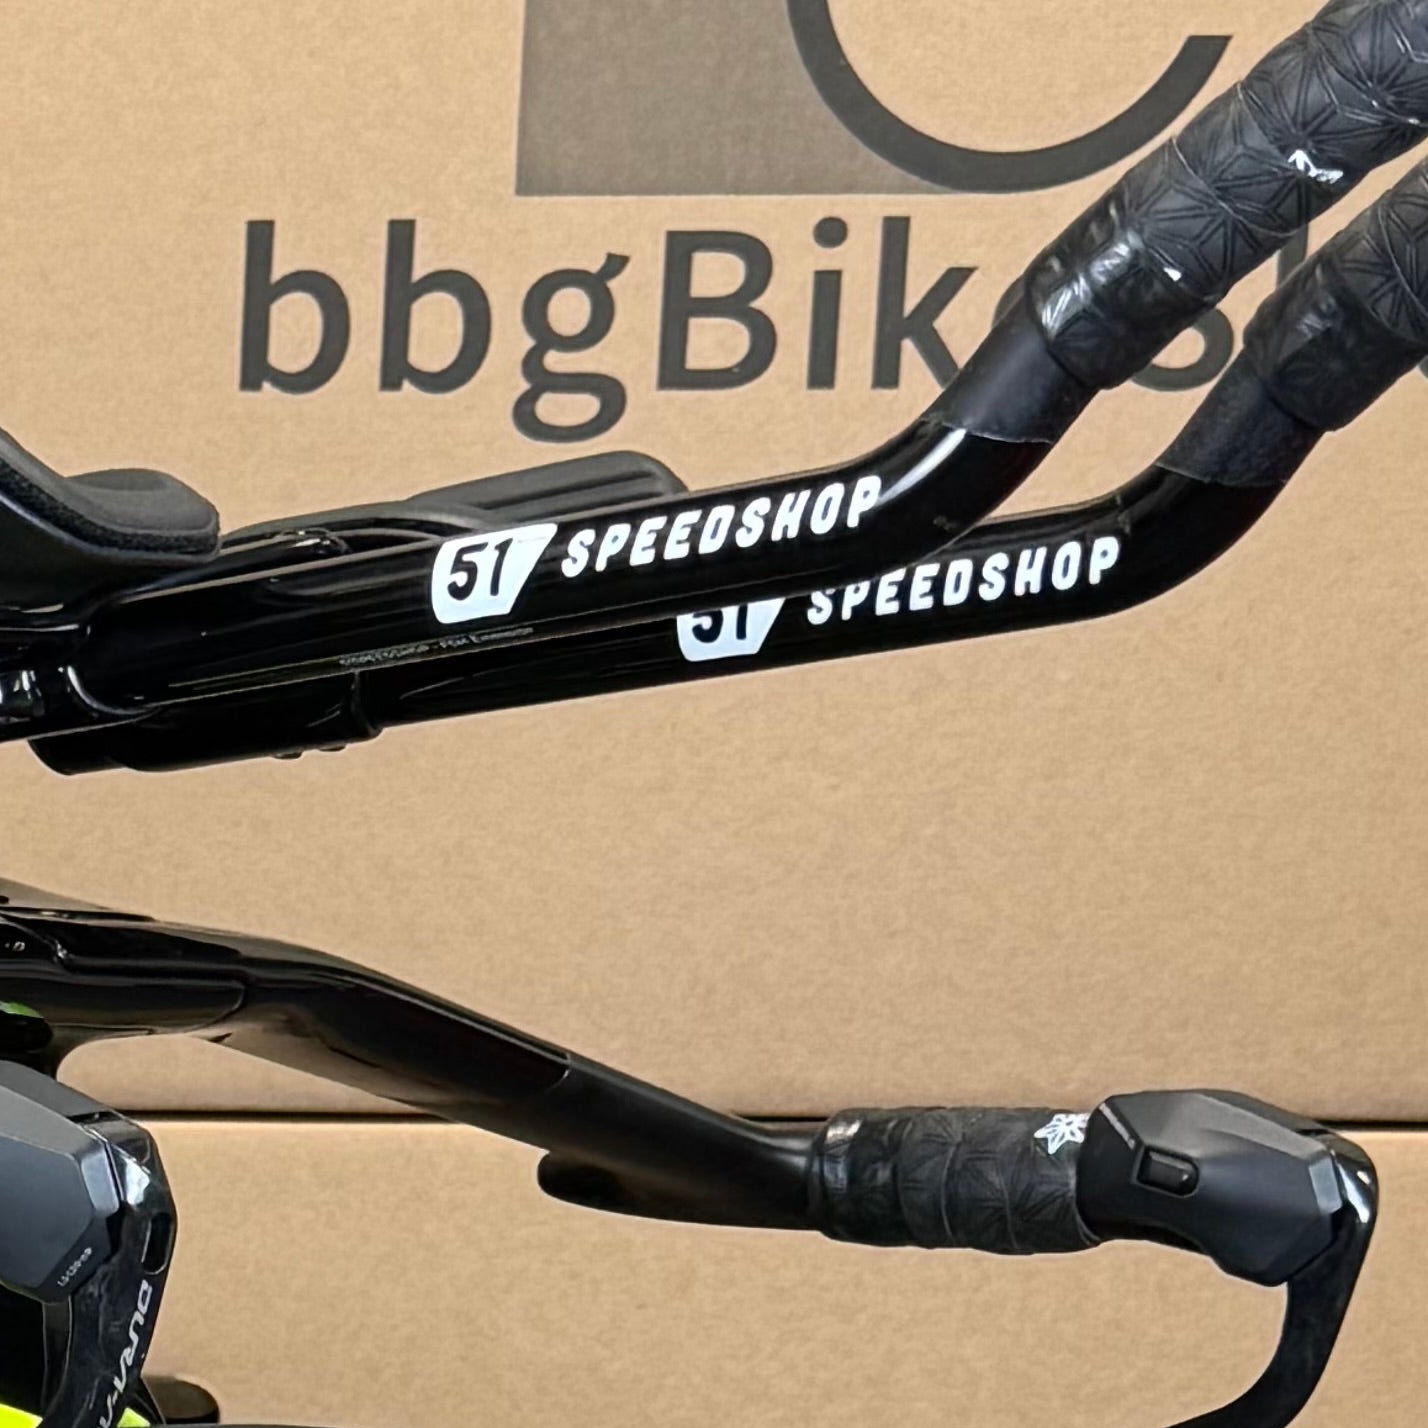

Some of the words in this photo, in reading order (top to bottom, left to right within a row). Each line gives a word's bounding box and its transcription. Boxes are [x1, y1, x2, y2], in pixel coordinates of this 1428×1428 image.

[237, 217, 1428, 442] bbgBik
[446, 537, 513, 601] 51
[560, 474, 883, 578] SPEEDSHOP
[806, 536, 1120, 626] SPEEDSHOP
